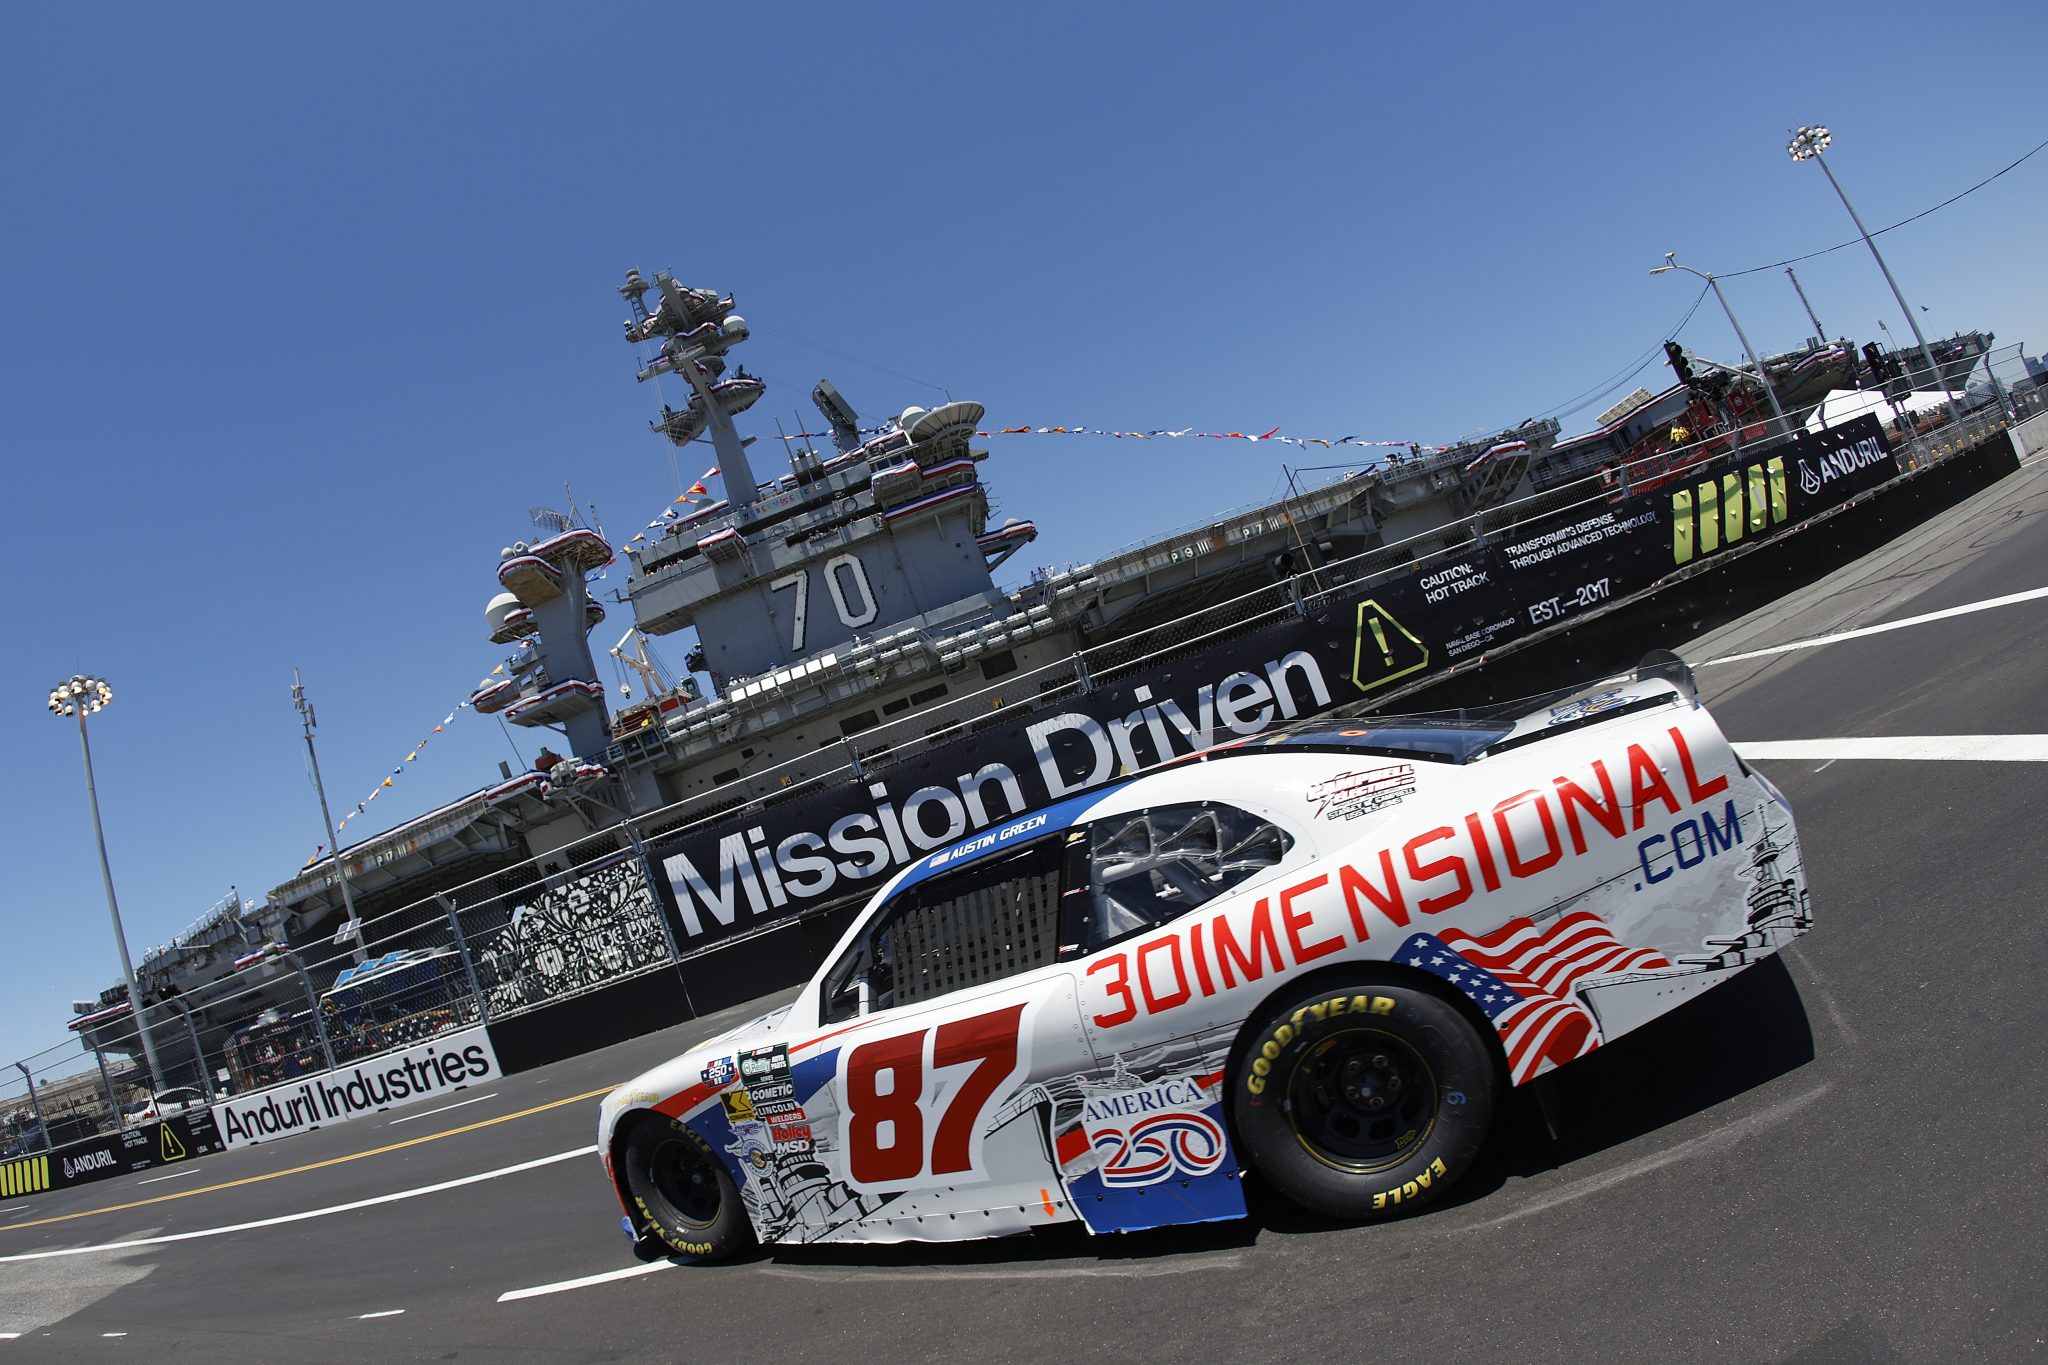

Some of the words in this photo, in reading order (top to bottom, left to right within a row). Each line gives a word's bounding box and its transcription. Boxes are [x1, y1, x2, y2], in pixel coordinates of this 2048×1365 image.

[1819, 436, 1887, 484] ANDURIL
[1505, 526, 1577, 557] TRANSFORMING
[1573, 512, 1616, 534] DEFENSE
[1510, 549, 1557, 570] THROUGH
[1557, 531, 1603, 556] ADVANCED
[1601, 511, 1657, 540] TECHNOLOGY
[1420, 562, 1474, 591] CAUTION:
[1425, 586, 1452, 604] HOT
[1451, 571, 1490, 595] TRACK
[770, 553, 880, 653] 70
[1445, 636, 1466, 650] NAVAL
[1465, 630, 1481, 643] BASE
[1481, 617, 1515, 637] CORONADO
[1448, 646, 1462, 657] SAN
[663, 762, 1028, 938] Mission
[1024, 650, 1332, 796] Driven
[950, 833, 997, 860] AUSTIN
[999, 814, 1047, 841] GREEN
[1634, 799, 1744, 892] .COM
[1086, 726, 1729, 1029] 3DIMENSIONAL
[1247, 995, 1396, 1095] GOODYEAR
[708, 1064, 728, 1079] 250
[751, 1083, 793, 1101] COMETIC
[847, 1001, 1031, 1184] 87
[225, 1084, 321, 1144] Anduril
[317, 1045, 490, 1119] Industries
[758, 1102, 795, 1115] LINCOLN
[1086, 1081, 1204, 1122] AMERICA
[669, 1118, 712, 1152] EAGLE
[770, 1113, 802, 1123] WELDERS
[771, 1124, 812, 1142] Holley
[74, 1149, 117, 1174] ANDURIL
[777, 1140, 810, 1154] MSD
[1091, 1113, 1222, 1183] 250
[1372, 1156, 1448, 1210] EAGLE
[635, 1195, 713, 1255] GOODYEAR
